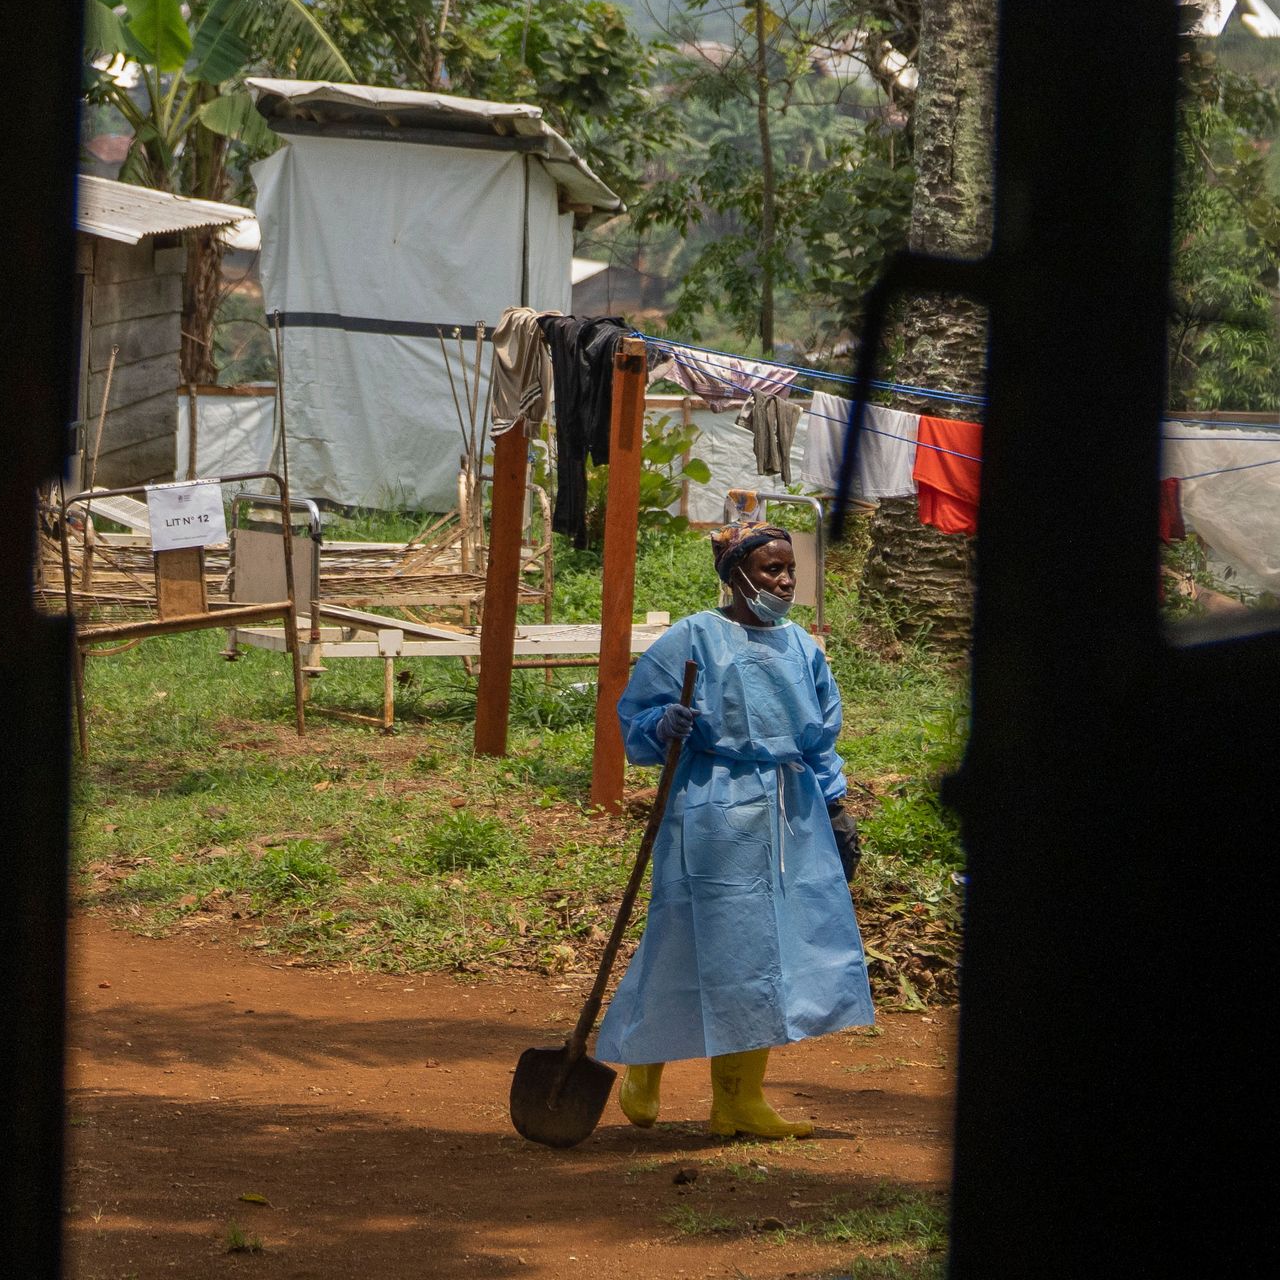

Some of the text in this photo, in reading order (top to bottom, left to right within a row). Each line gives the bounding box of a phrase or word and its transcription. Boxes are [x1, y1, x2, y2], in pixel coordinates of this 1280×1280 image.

[166, 514, 210, 527] LIT N° 12
